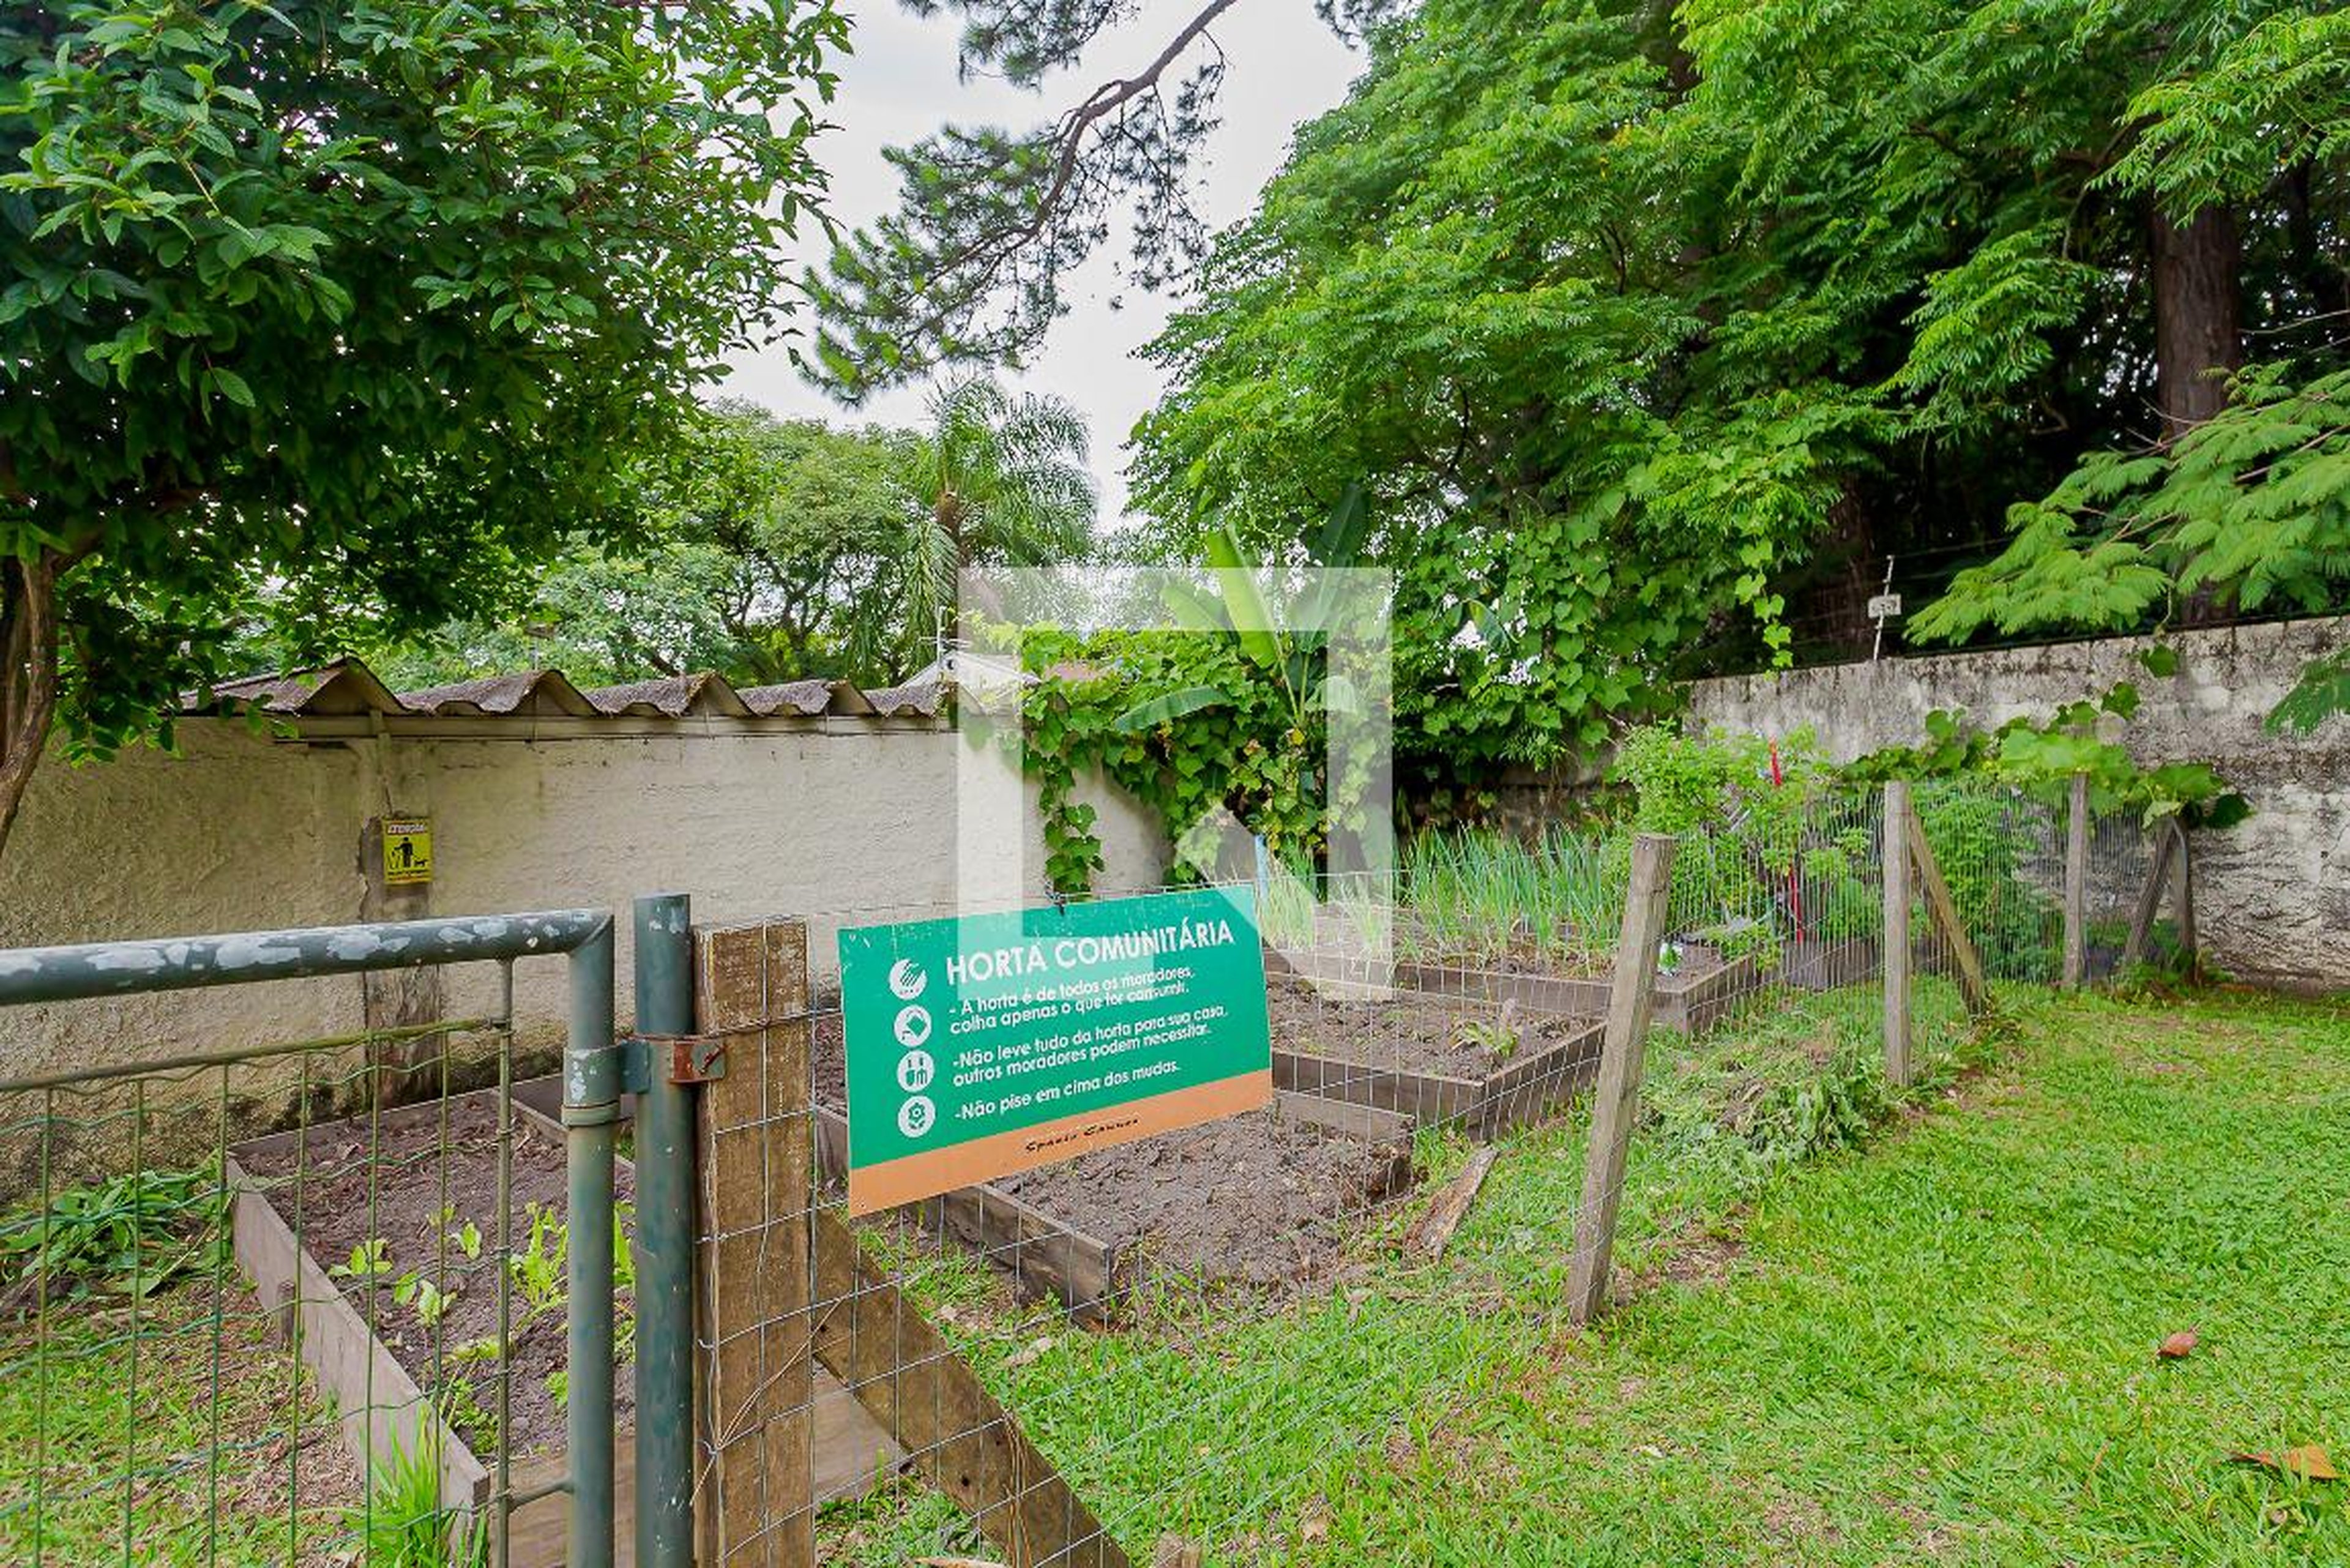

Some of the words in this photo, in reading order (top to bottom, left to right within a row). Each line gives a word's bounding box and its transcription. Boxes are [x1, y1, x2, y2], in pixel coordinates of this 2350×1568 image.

[947, 944, 1048, 985] HORTA
[1054, 916, 1234, 969] COMUNITÁRIA
[950, 1015, 996, 1034] colha
[1001, 1004, 1058, 1028] apenas
[1061, 1003, 1071, 1014] o
[1075, 996, 1102, 1016] que
[1106, 992, 1123, 1007] for
[961, 999, 973, 1015] A
[977, 995, 1018, 1012] horta
[1022, 987, 1032, 1005] é
[1037, 986, 1056, 1001] de
[1060, 979, 1100, 999] todos
[1104, 977, 1118, 991] os
[998, 1044, 1031, 1060] leve
[1035, 1034, 1069, 1053] tudo
[1073, 1029, 1091, 1045] da
[1095, 1023, 1132, 1040] horta
[1135, 1016, 1165, 1034] para
[1168, 1012, 1190, 1026] sua
[953, 1065, 1002, 1087] outros
[1007, 1048, 1086, 1075] moradores
[1090, 1039, 1140, 1061] podem
[1000, 1094, 1031, 1114] pise
[1036, 1087, 1060, 1101] em
[1064, 1078, 1100, 1096] cima
